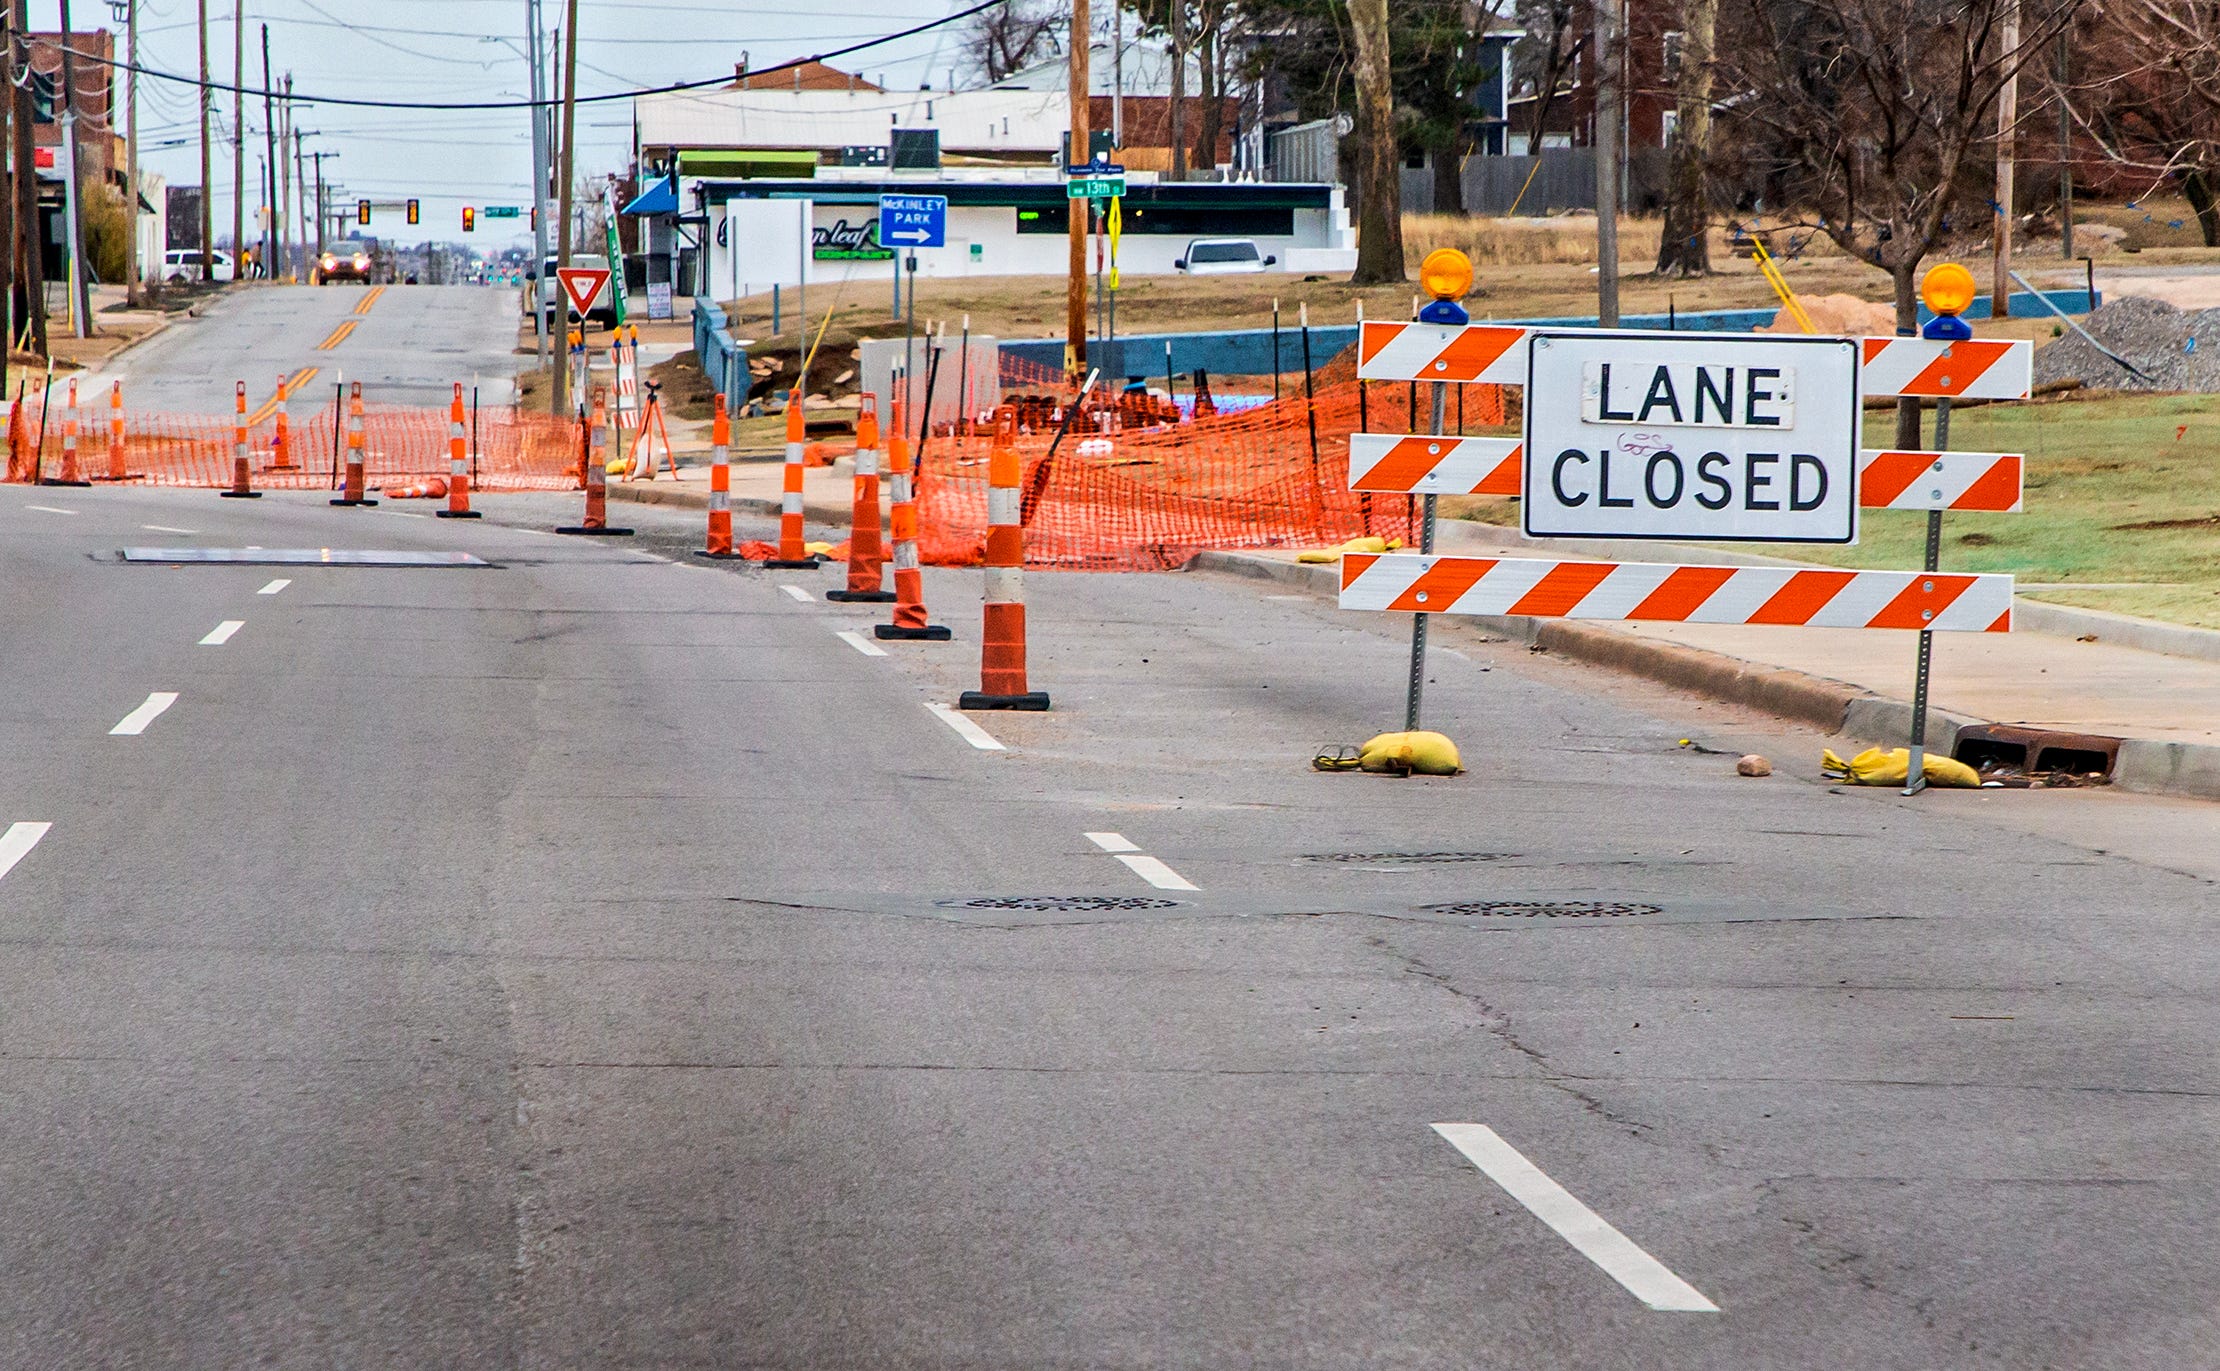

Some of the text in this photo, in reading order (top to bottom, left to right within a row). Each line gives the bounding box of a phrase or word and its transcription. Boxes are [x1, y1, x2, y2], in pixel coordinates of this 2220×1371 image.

[1086, 181, 1110, 195] 13th
[895, 213, 931, 224] PARK
[831, 220, 871, 251] leaf
[1599, 363, 1780, 425] LANE
[1552, 449, 1828, 511] CLOSED
